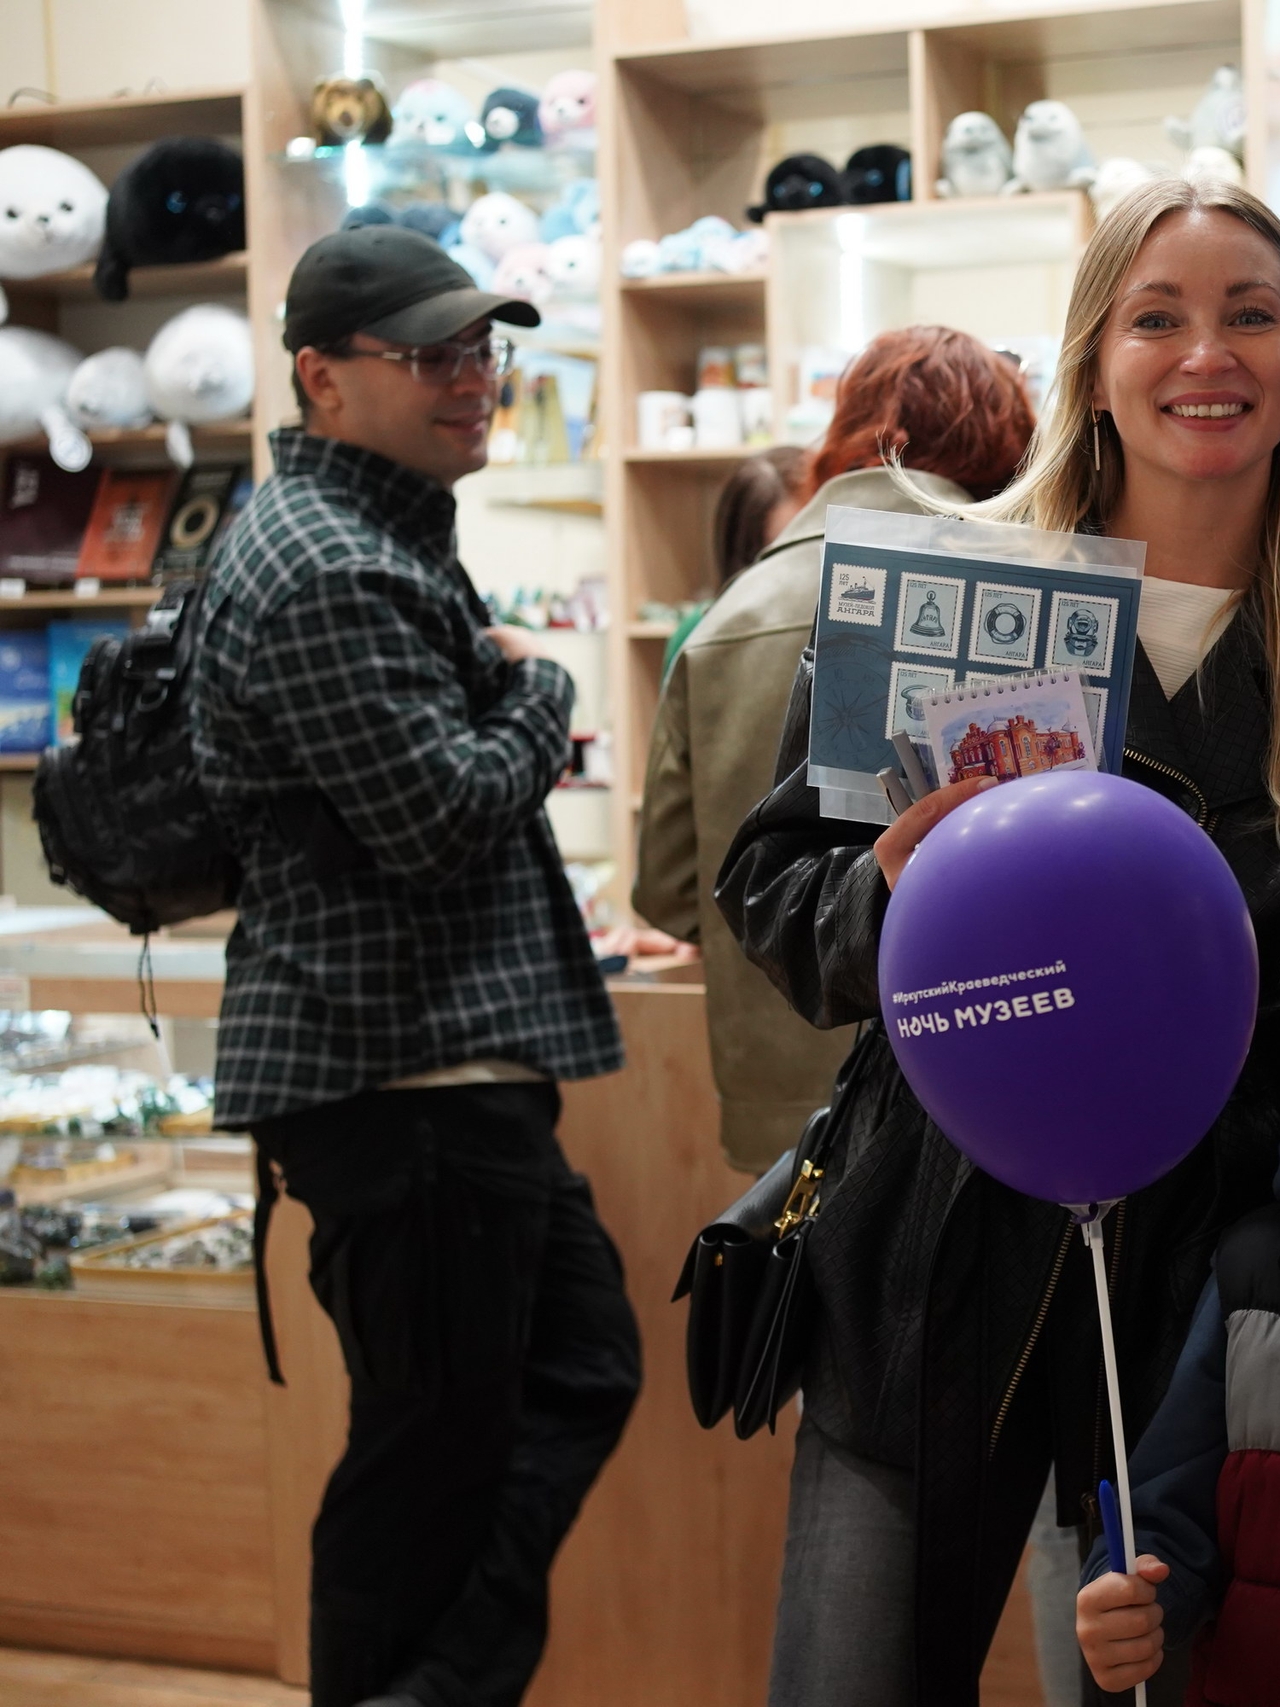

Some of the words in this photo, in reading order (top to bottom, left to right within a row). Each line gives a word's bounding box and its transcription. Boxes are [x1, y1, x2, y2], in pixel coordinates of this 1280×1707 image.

[839, 573, 850, 581] 125
[836, 606, 875, 617] АНГАРА
[929, 641, 950, 649] АНГАРА
[1005, 650, 1026, 658] АНГАРА
[892, 960, 1067, 1006] #ИркутскийКраеведческий
[896, 1012, 950, 1038] НОЧЬ
[954, 987, 1075, 1029] МУЗЕЕВ
